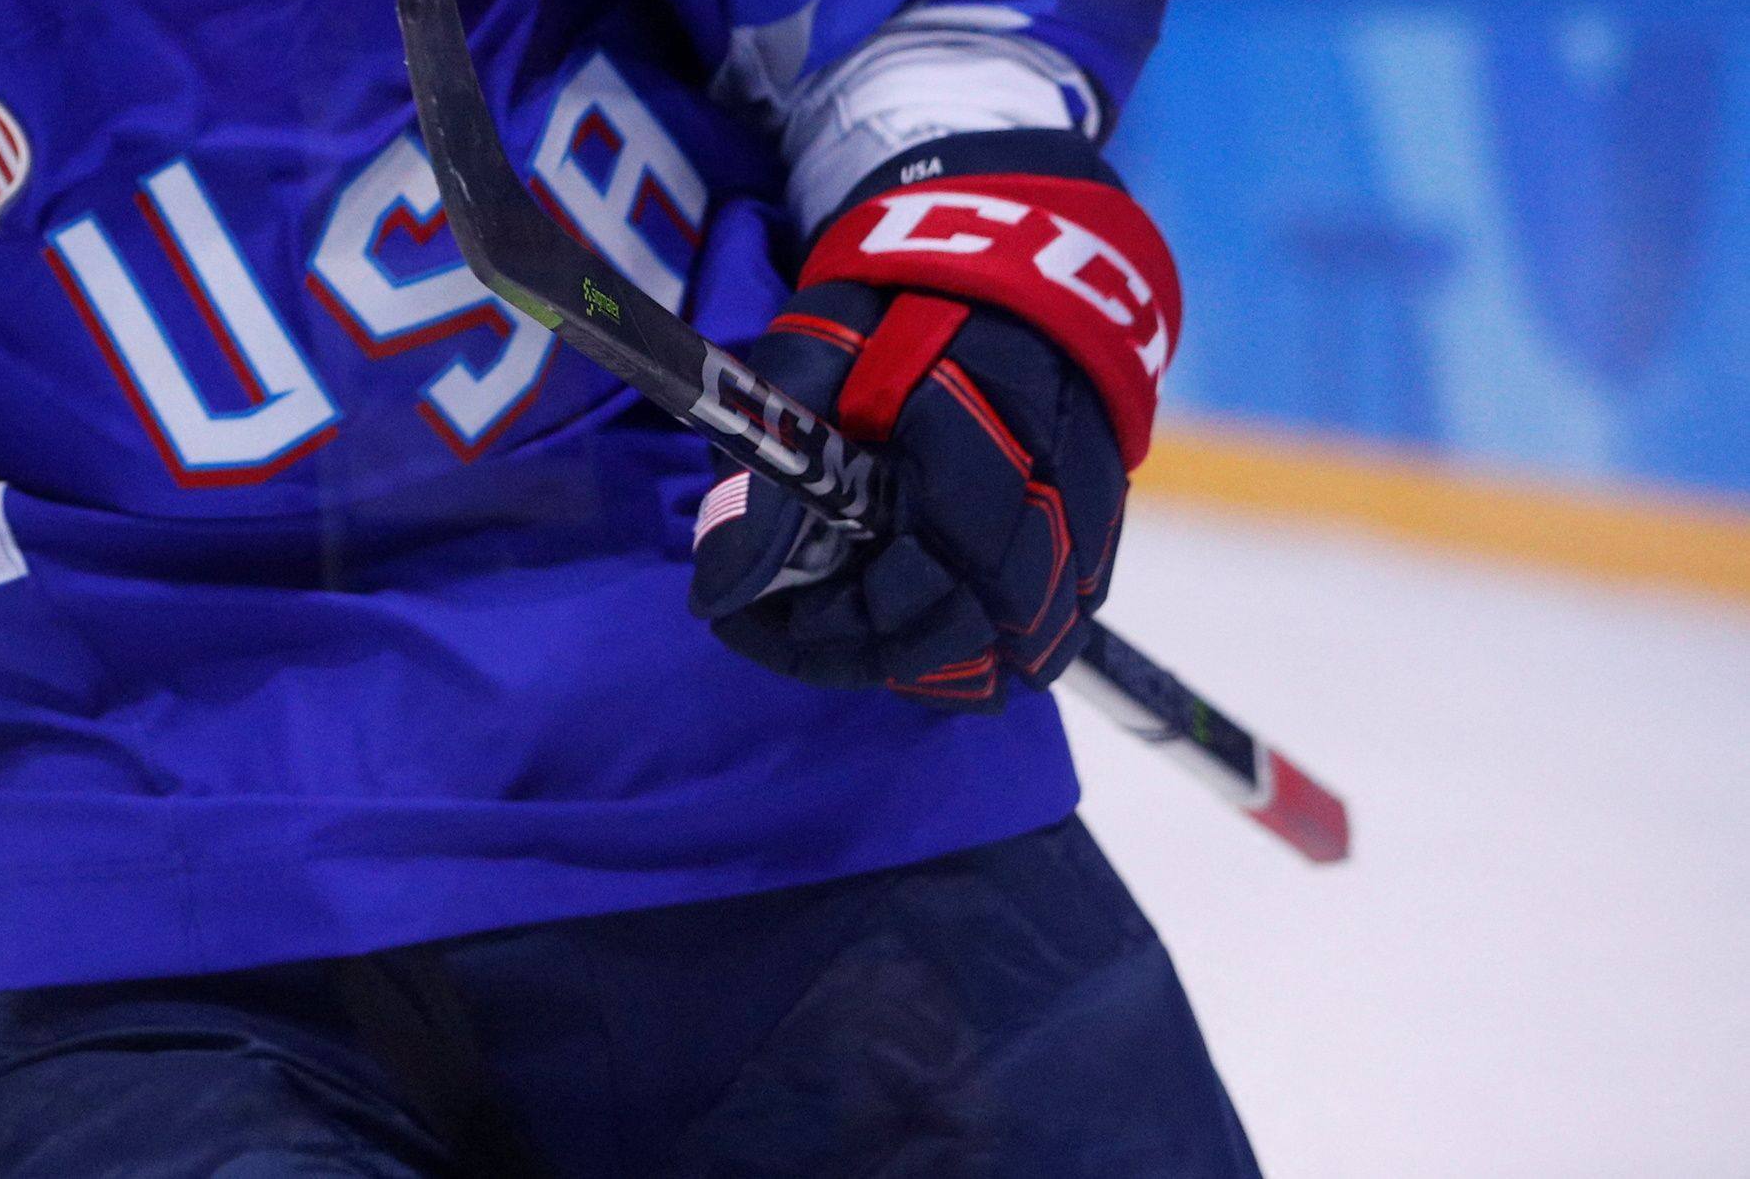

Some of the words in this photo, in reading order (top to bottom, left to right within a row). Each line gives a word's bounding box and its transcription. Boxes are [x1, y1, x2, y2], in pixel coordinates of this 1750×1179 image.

[900, 157, 943, 185] USA
[45, 50, 709, 487] USA
[688, 340, 875, 518] CCM
